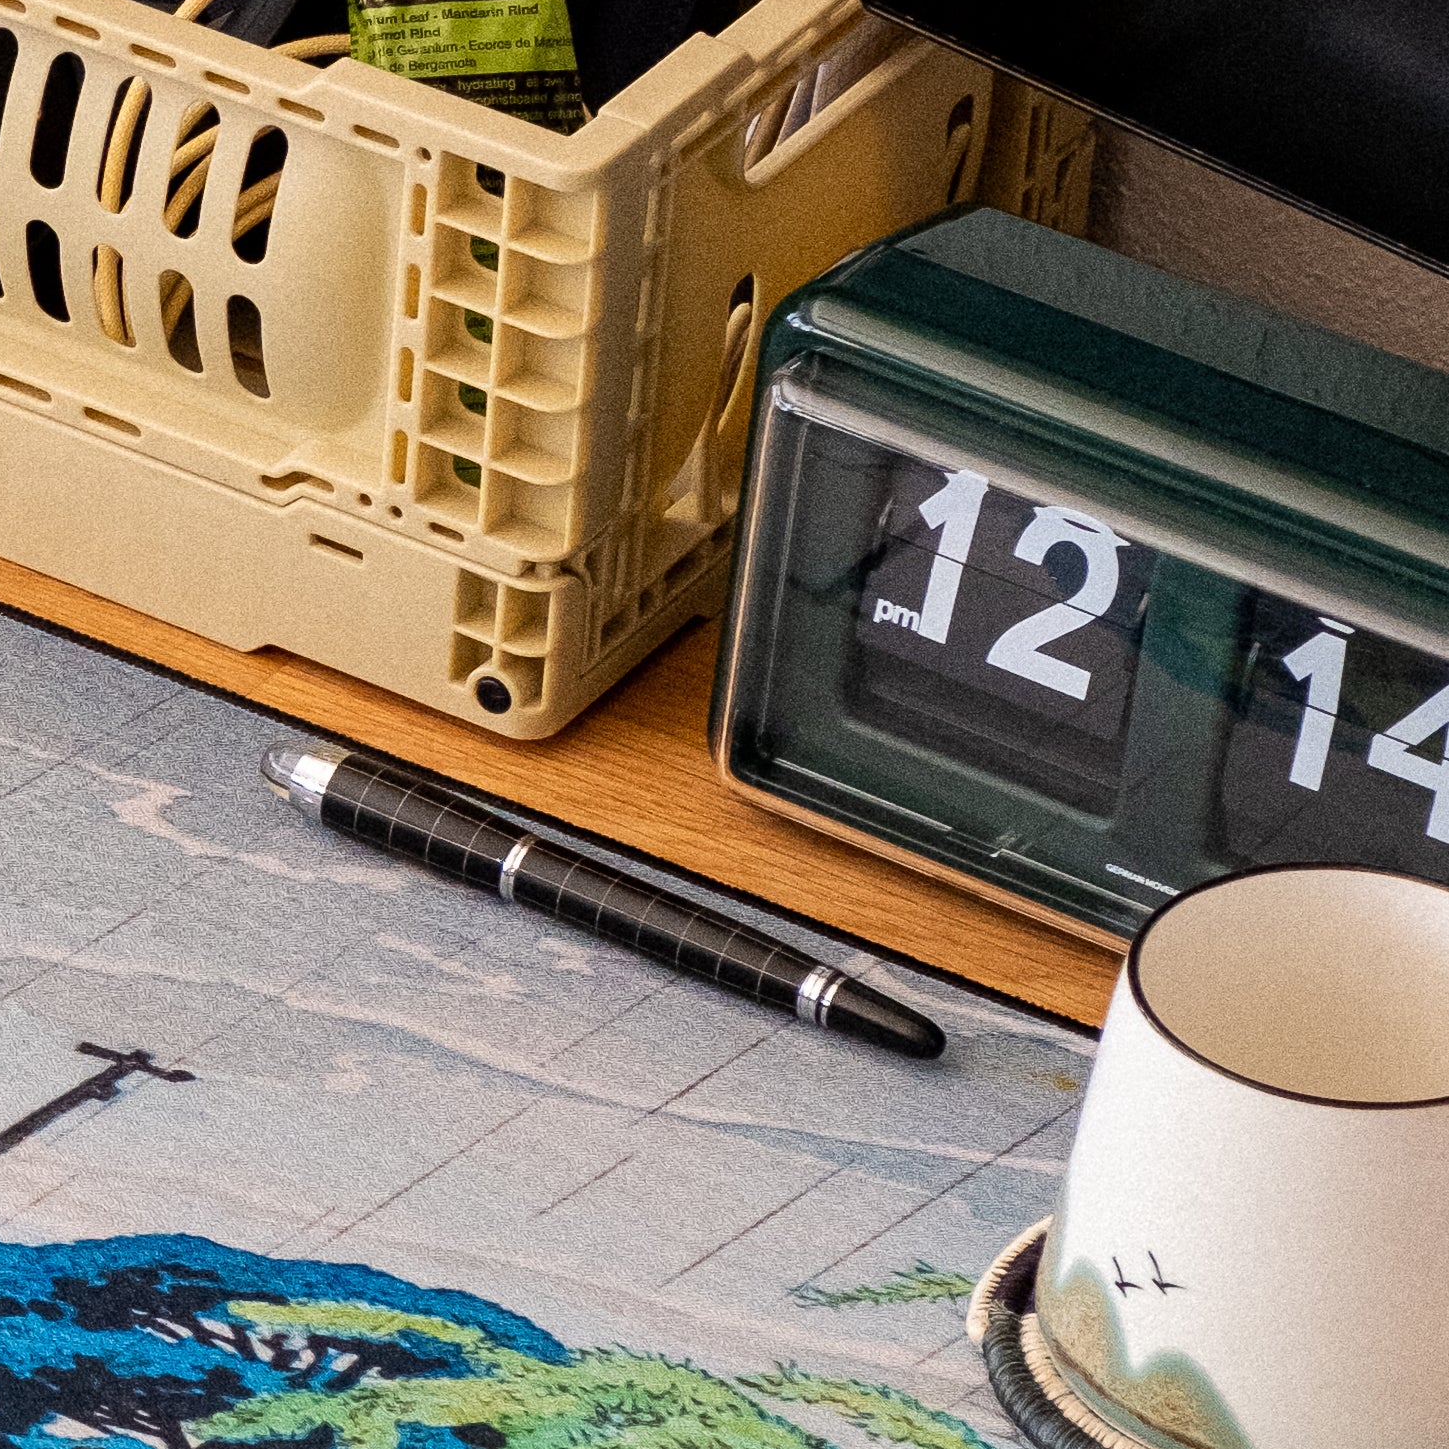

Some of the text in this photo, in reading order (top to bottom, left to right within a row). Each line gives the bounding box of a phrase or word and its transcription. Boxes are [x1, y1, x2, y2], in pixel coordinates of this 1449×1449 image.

[402, 11, 430, 24] Leaf
[508, 3, 540, 16] Rind
[873, 469, 1131, 701] pm 12
[1282, 618, 1449, 845] 14
